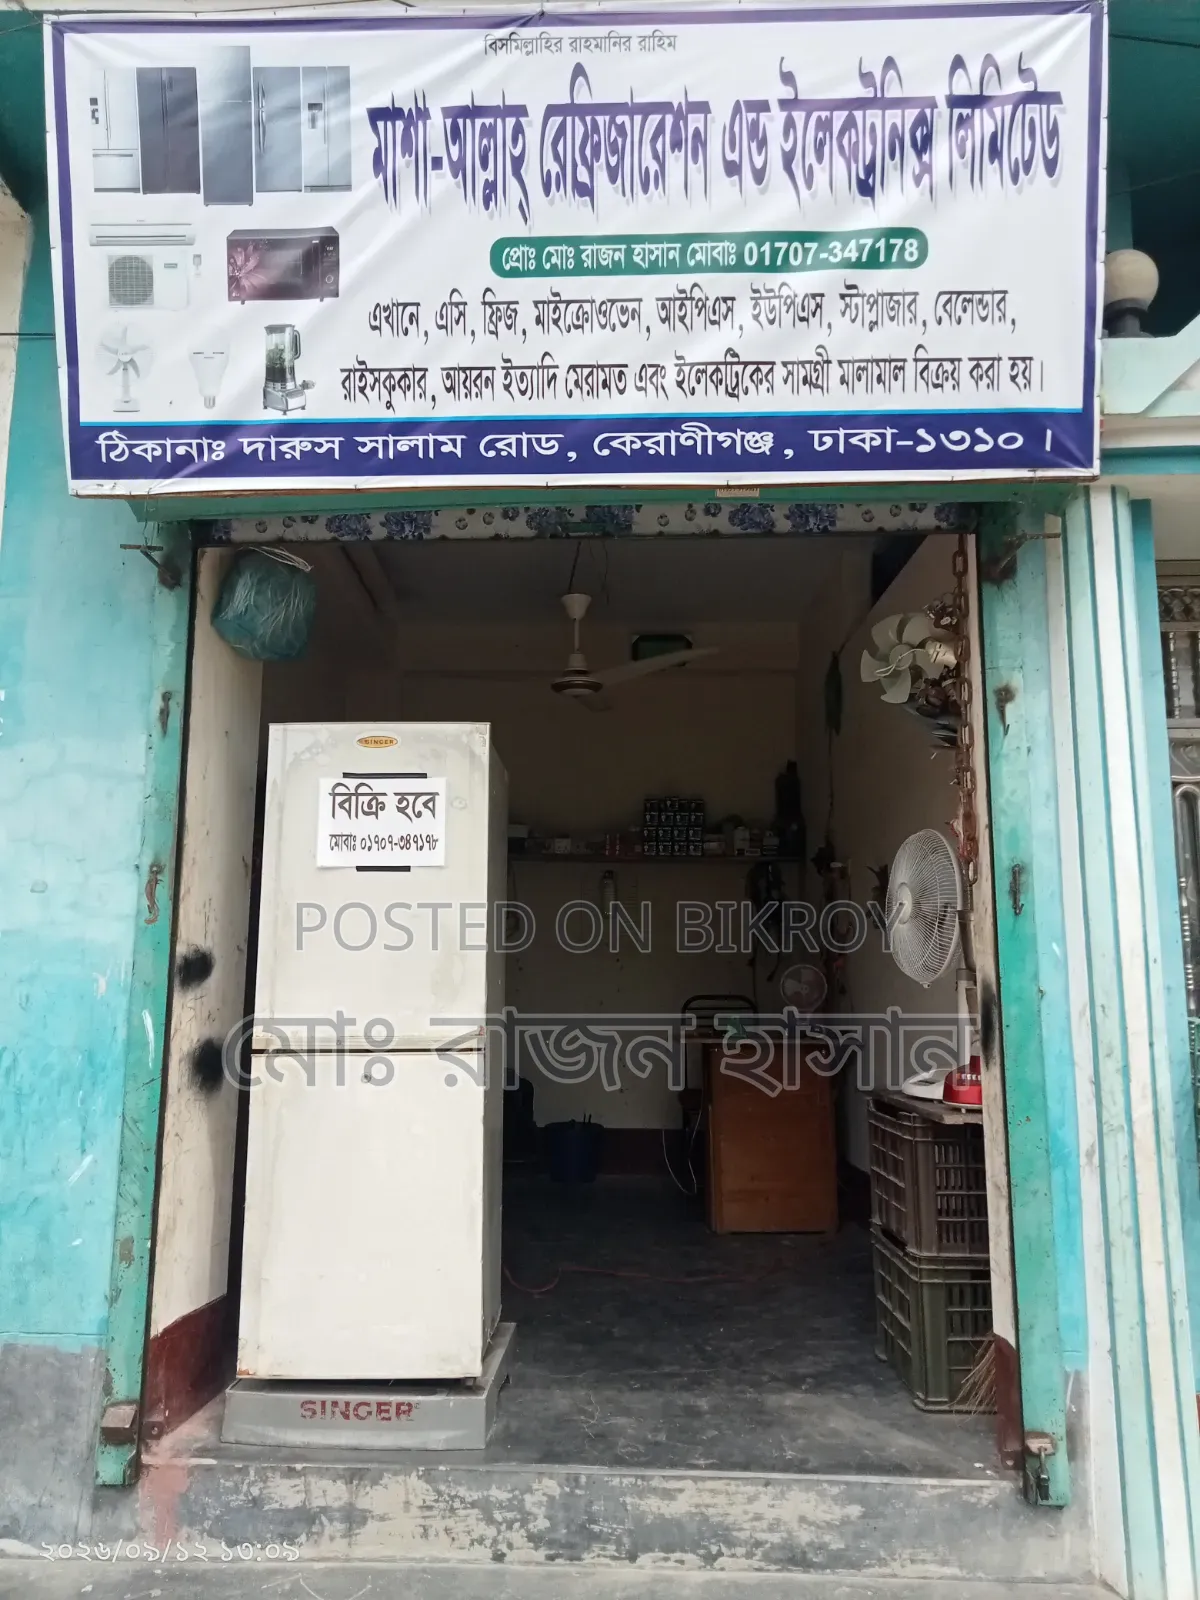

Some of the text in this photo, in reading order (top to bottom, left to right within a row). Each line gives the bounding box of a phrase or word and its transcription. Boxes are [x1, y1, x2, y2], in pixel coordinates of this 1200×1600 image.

[484, 29, 678, 56] বিসমিল্লাহির রাহমানির রাহিম
[540, 62, 712, 215] রেফ্রিজারেশন
[722, 99, 772, 200] এন্ড
[777, 55, 938, 212] ইলেকট্রনিক্স
[945, 51, 1064, 190] লিমিটেড
[502, 236, 920, 273] প্রোঃ মোঃ রাজন হাসান মোবাঃ 01707-347178
[369, 297, 429, 345] এখানে,
[435, 288, 476, 345] এসি,
[481, 287, 527, 344] ফ্রিজ,
[532, 286, 651, 342] মাইক্রোওভেন,
[655, 281, 744, 339] আইপিএস,
[750, 279, 833, 338] ইউপিএস,
[340, 355, 438, 415] রাইসকুকার,
[440, 363, 496, 404] আয়রন
[500, 351, 559, 401] ইত্যাদি
[564, 361, 628, 402] মেরামত
[633, 363, 670, 401] এবং
[674, 347, 776, 403] ইলেকট্রিকের
[781, 344, 832, 398] সামগ্রী
[837, 353, 908, 396] মালামাল
[912, 343, 962, 394] বিক্রয়
[967, 352, 1002, 393] করা
[96, 430, 226, 464] ঠিকানাঃ
[237, 436, 345, 461] দারুস
[353, 433, 468, 460] সালাম
[807, 425, 1024, 455] ঢাকা-১৩১০
[328, 782, 440, 823] বিক্রি হবে
[329, 832, 438, 852] মোবাঃ ০১৭০৭-৩৪৭১৭৮
[301, 1400, 413, 1421] SINGER
